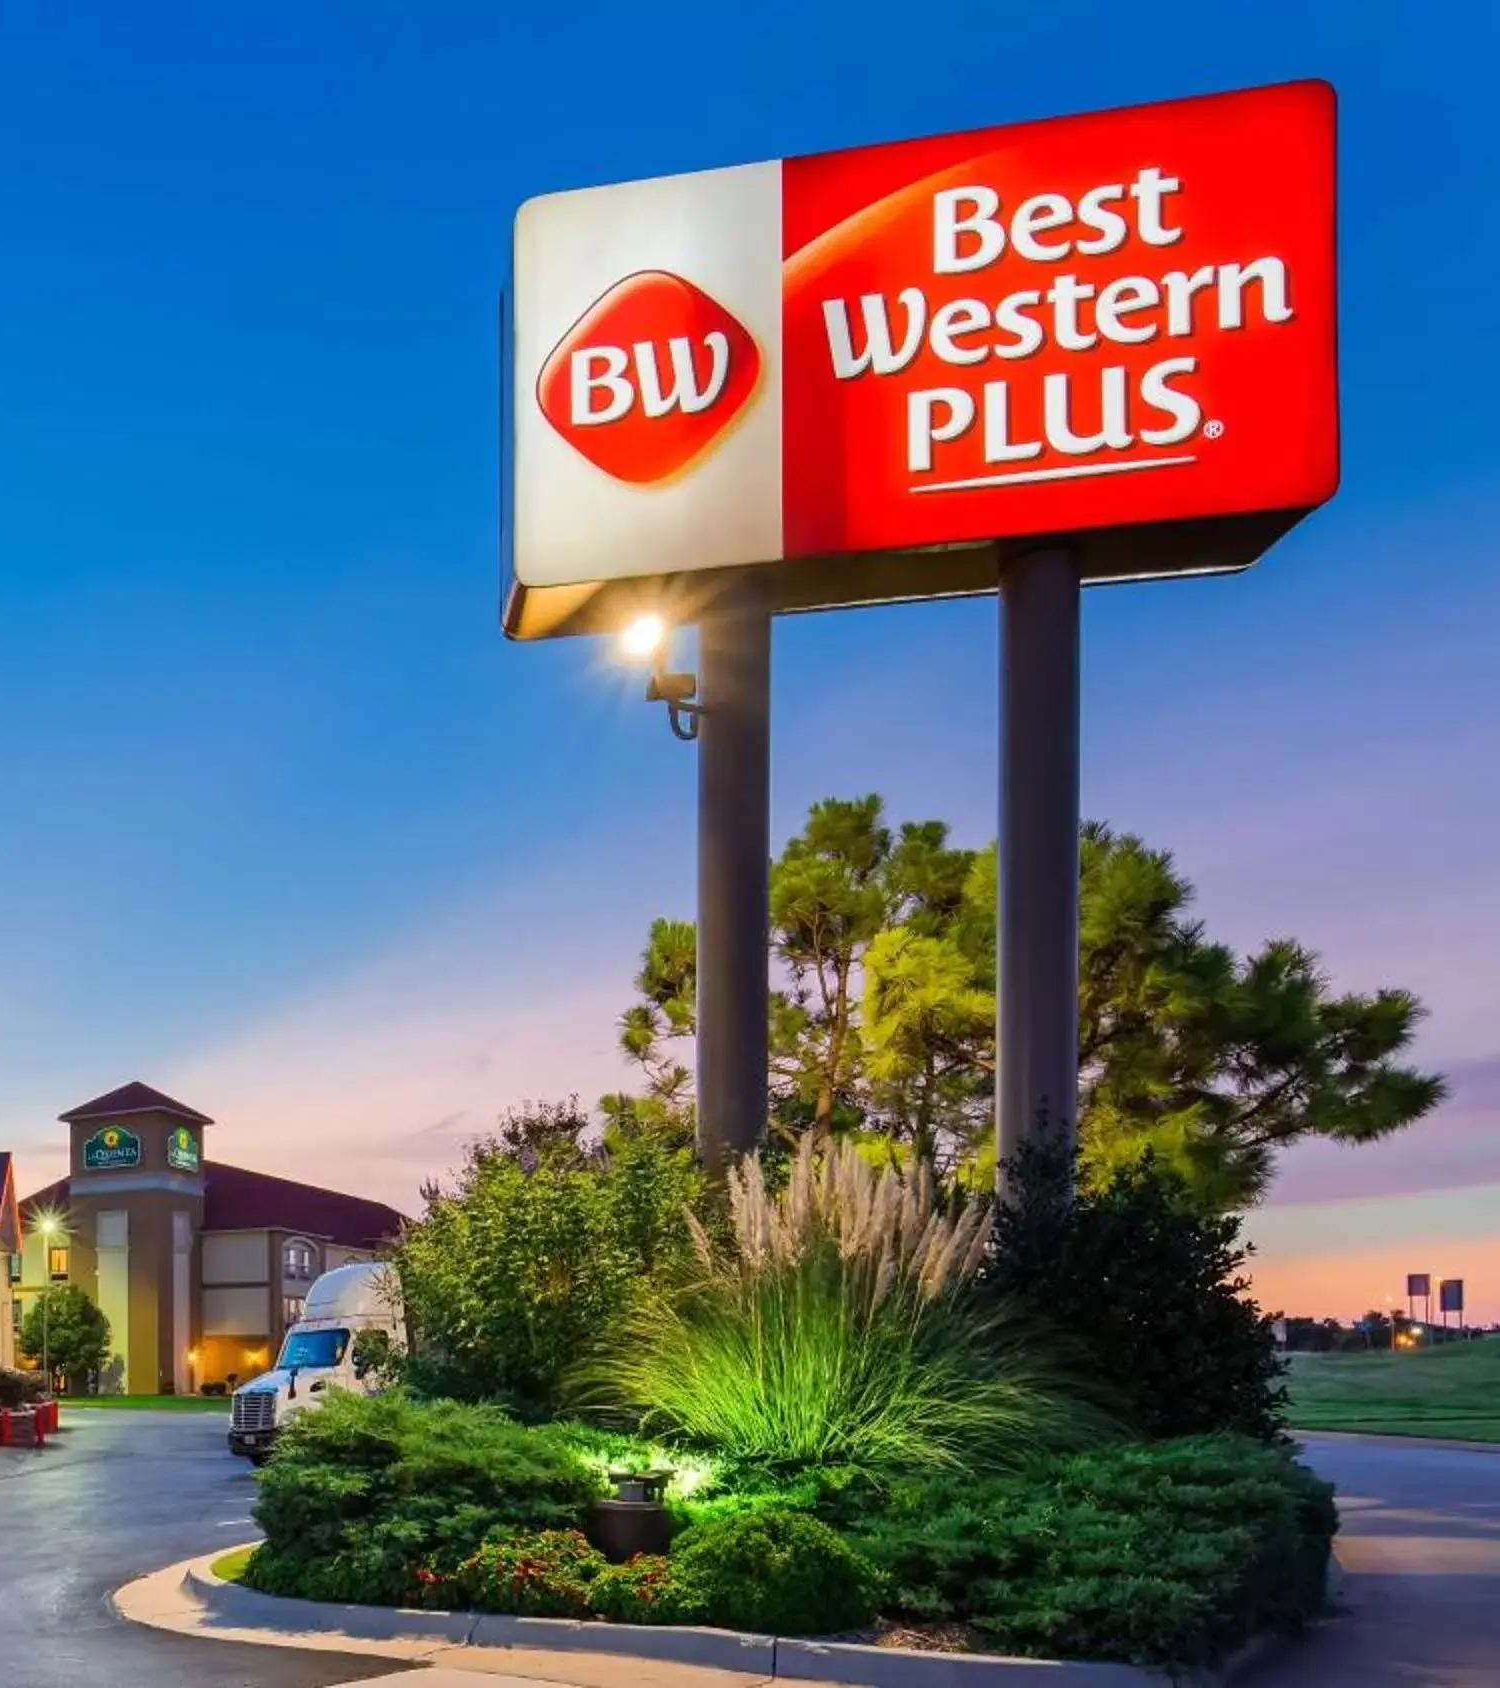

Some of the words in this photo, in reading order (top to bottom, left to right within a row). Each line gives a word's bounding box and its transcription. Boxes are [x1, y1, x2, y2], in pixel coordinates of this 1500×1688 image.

[933, 168, 1184, 275] Best
[822, 256, 1294, 380] Western
[570, 331, 729, 426] BW
